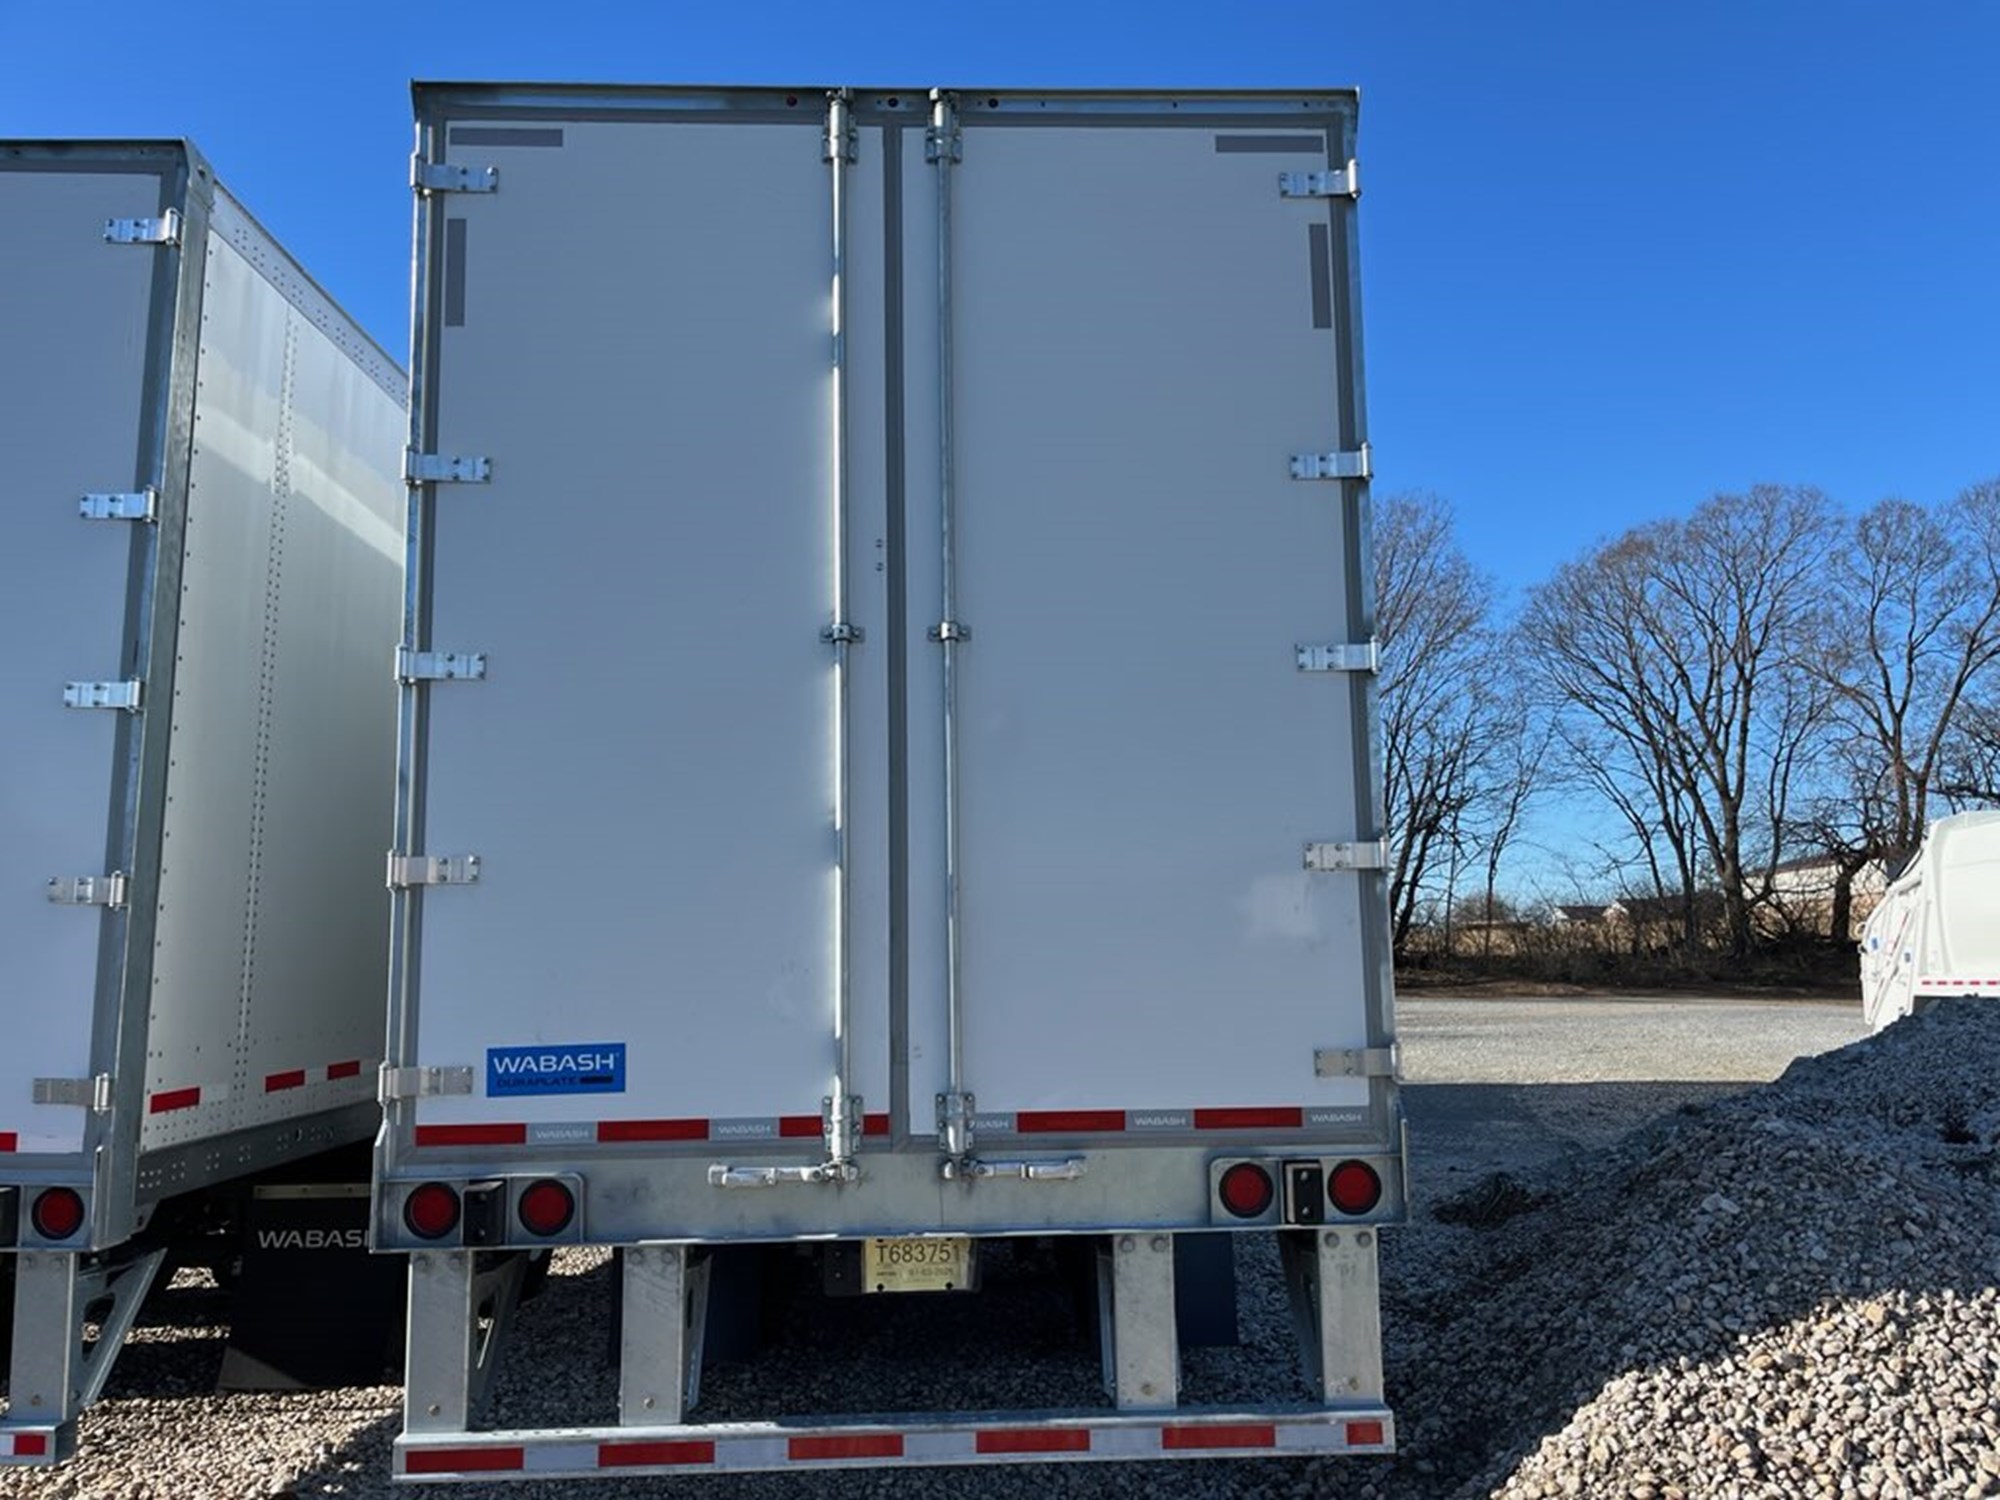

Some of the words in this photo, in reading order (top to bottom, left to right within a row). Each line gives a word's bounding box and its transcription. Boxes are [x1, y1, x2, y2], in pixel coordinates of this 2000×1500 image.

[493, 1053, 614, 1074] WABASH
[1133, 1116, 1185, 1126] WABASH
[1311, 1113, 1362, 1123] WABASH
[536, 1129, 589, 1139] WABASH
[717, 1125, 770, 1134] WABASH
